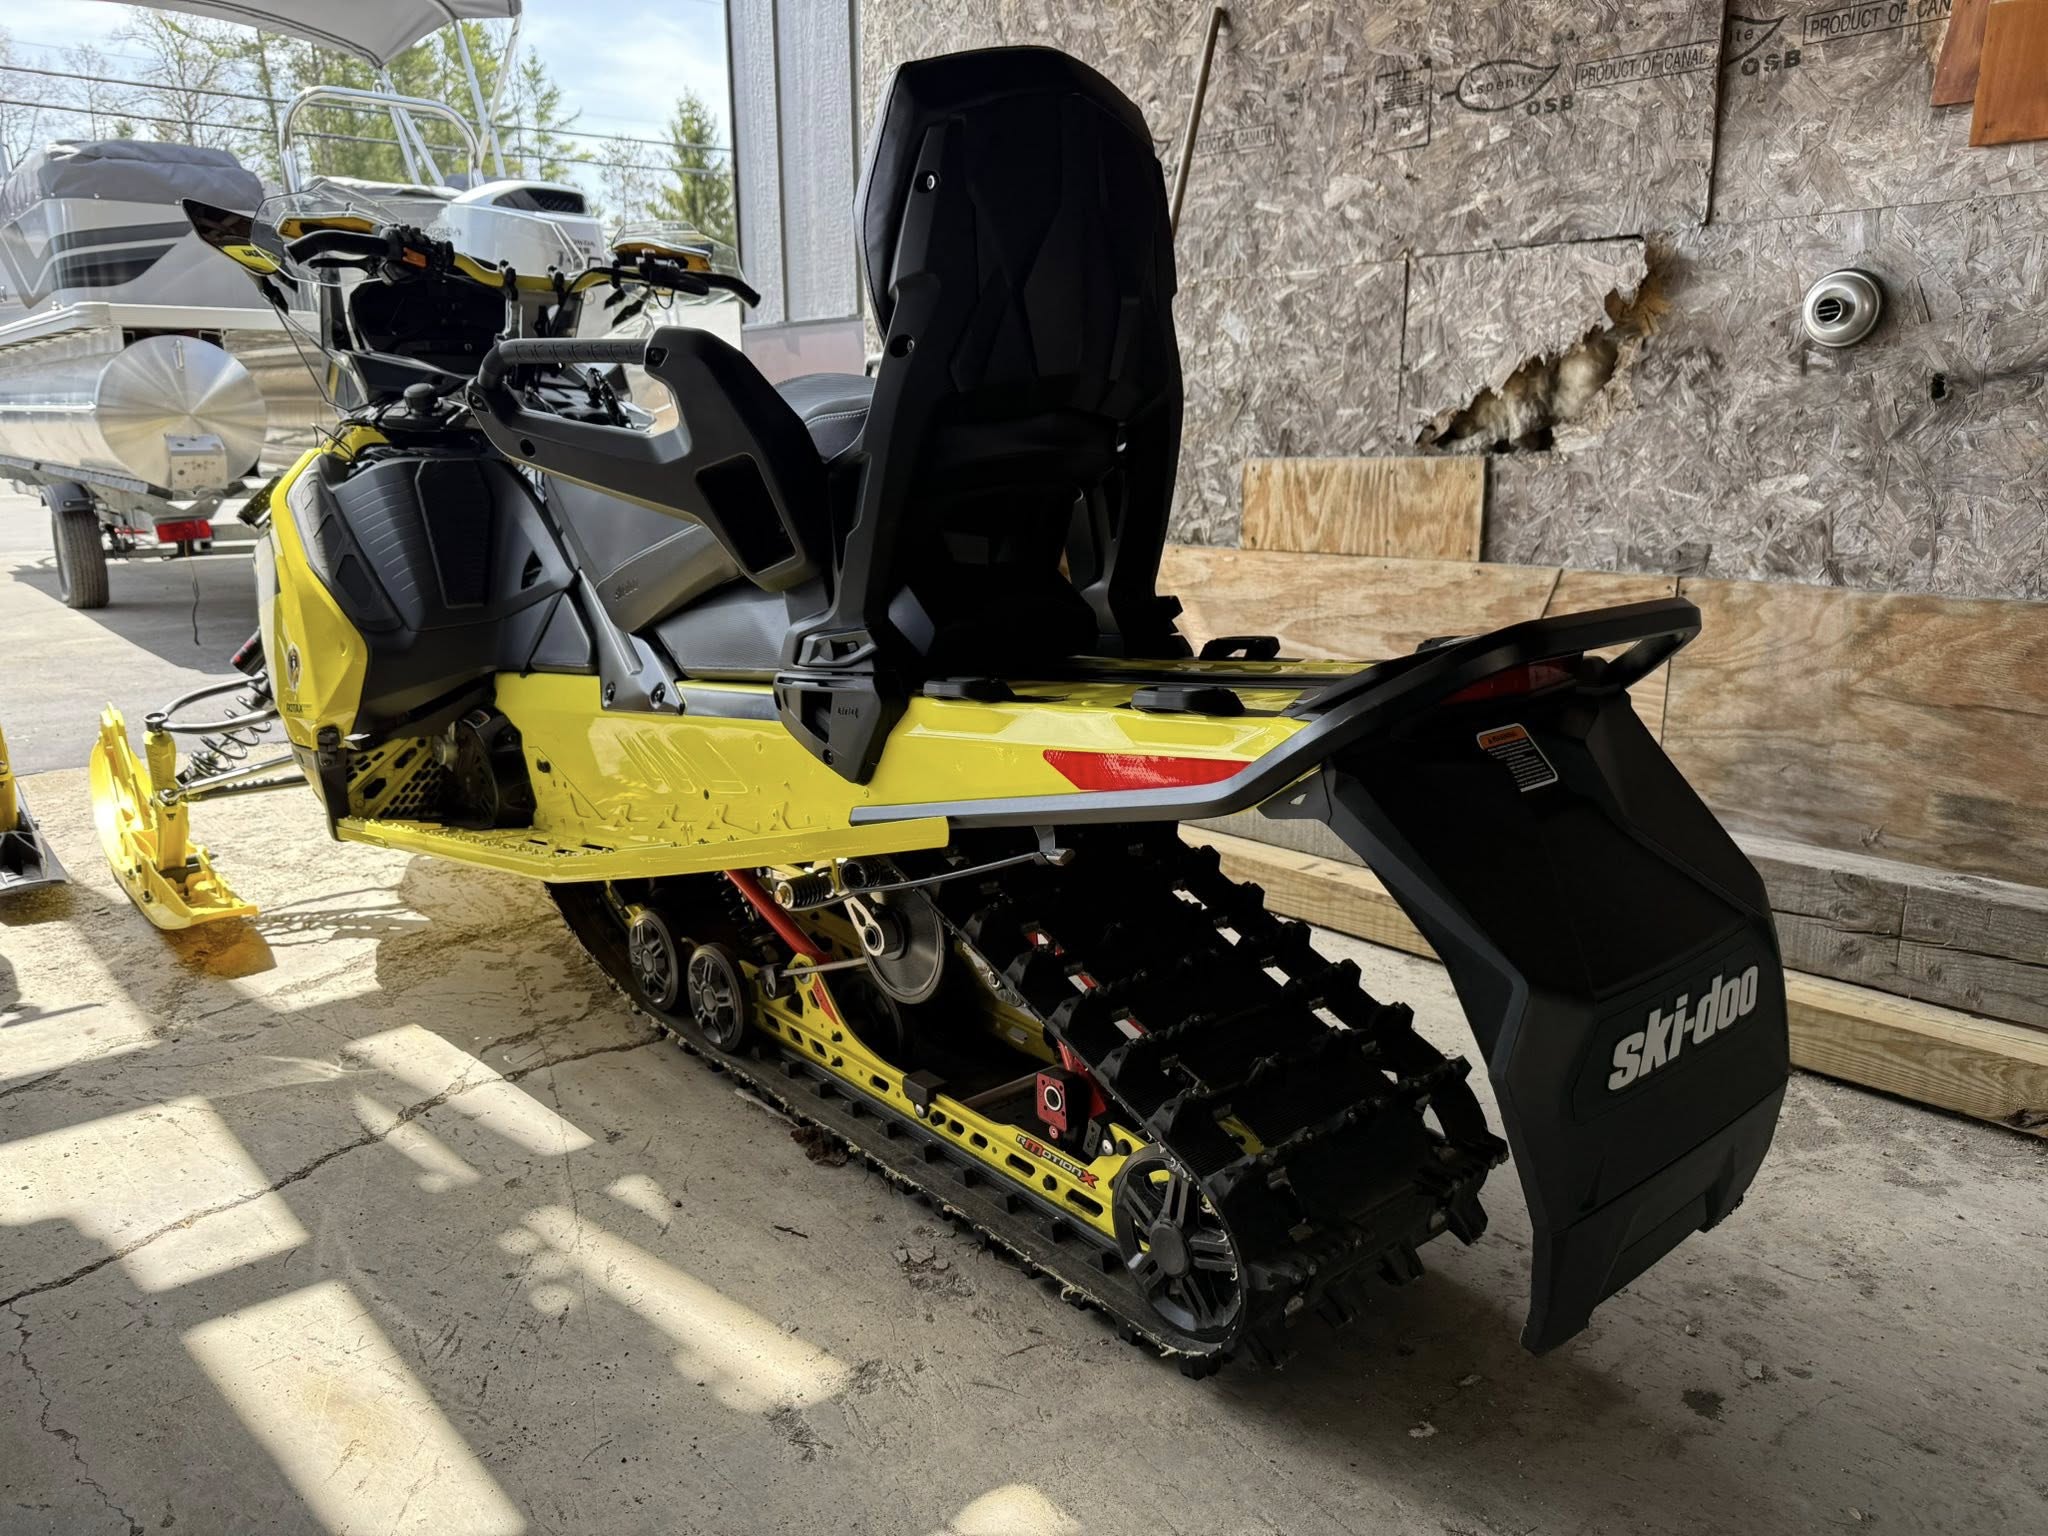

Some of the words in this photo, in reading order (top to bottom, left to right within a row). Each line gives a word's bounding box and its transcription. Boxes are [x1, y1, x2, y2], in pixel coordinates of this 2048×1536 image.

[1809, 7, 1879, 39] PRODUCT
[1888, 3, 1908, 24] OF
[1580, 58, 1637, 84] PRODUCT
[1641, 54, 1659, 74] OF
[1740, 49, 1801, 77] OSB
[1525, 94, 1575, 116] OSB
[1608, 965, 1759, 1091] ski-doo
